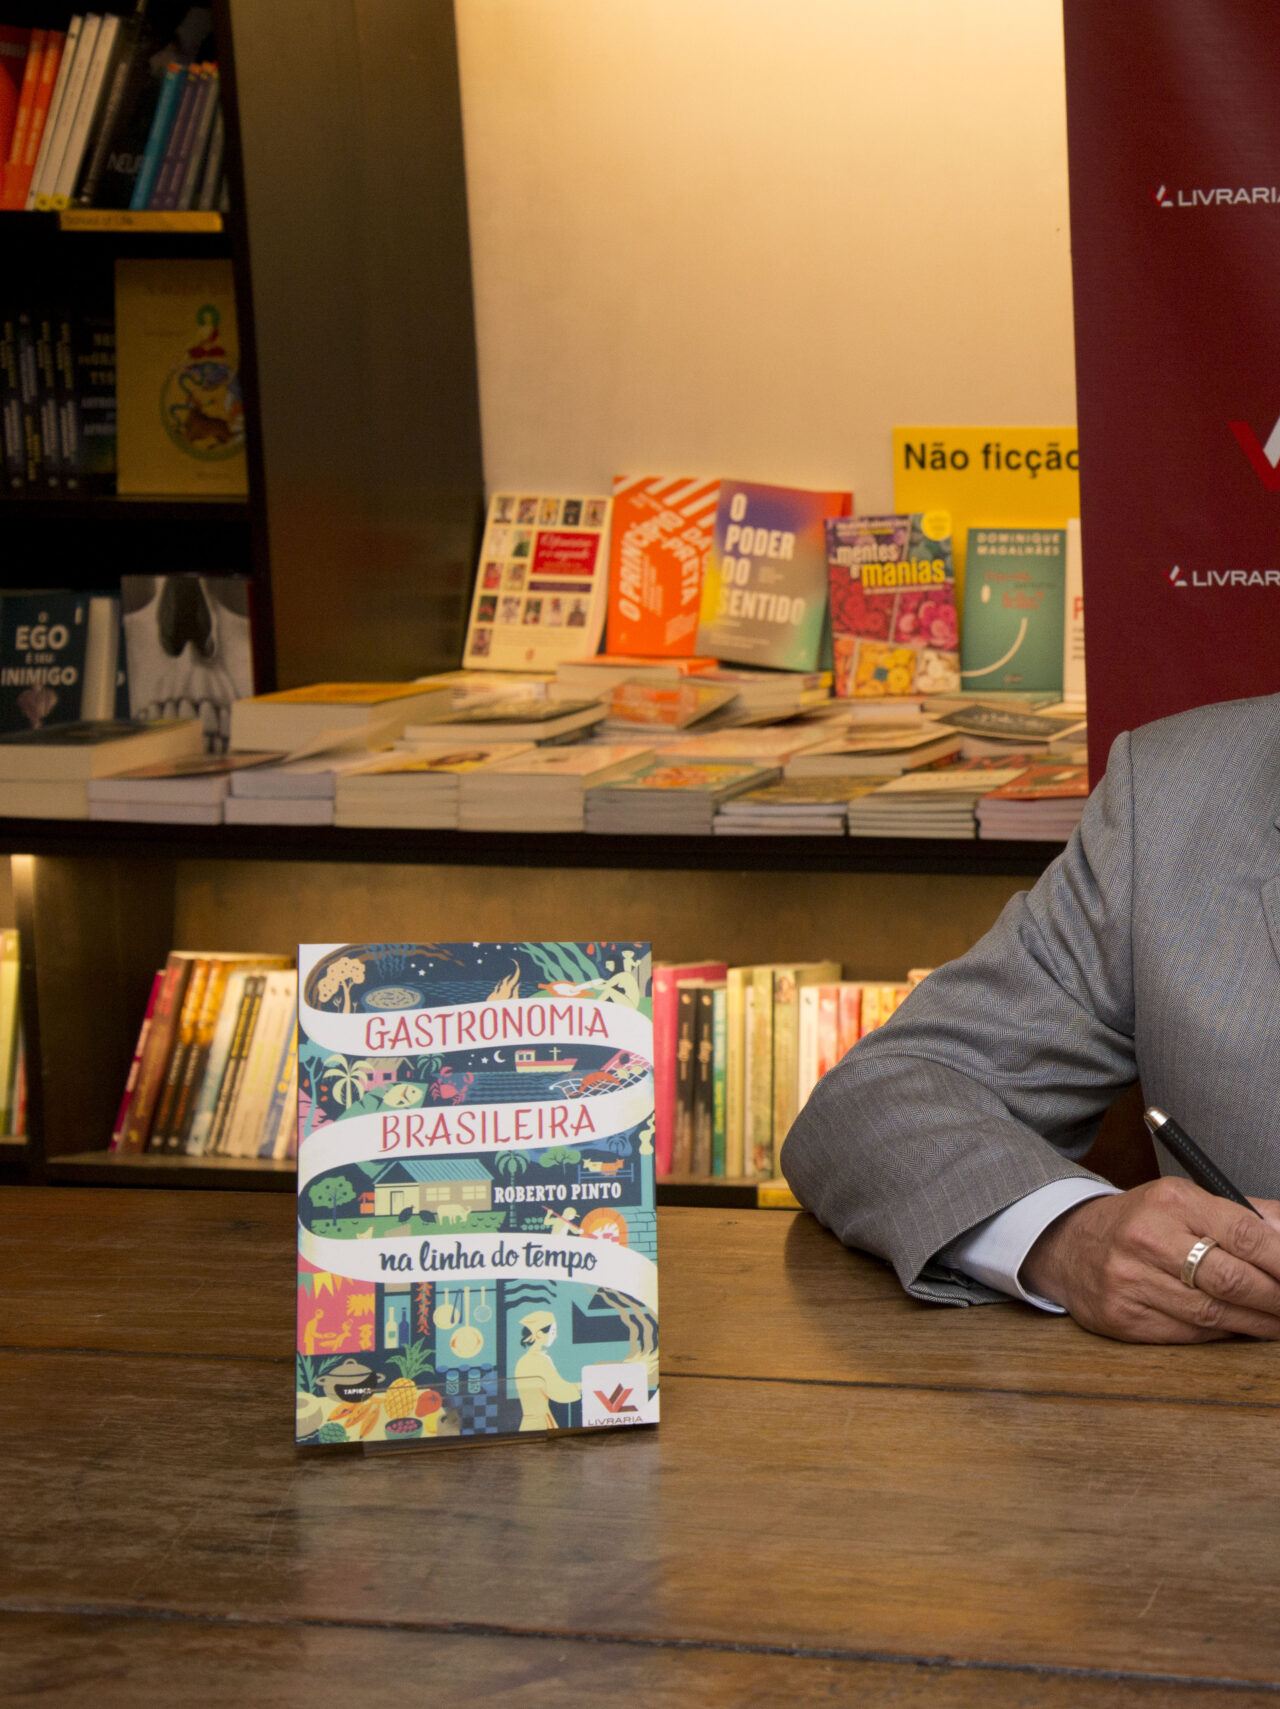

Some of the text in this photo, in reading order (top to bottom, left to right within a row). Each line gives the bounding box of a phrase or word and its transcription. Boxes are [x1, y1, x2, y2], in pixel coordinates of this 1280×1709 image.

[904, 441, 1079, 479] Não ficção
[724, 523, 796, 561] PODER
[836, 543, 899, 563] mentes
[720, 555, 752, 587] DO
[861, 556, 946, 588] manias
[716, 585, 807, 626] SENTIDO
[15, 624, 69, 651] EGO
[1, 666, 78, 687] INIMIGO
[365, 1004, 610, 1051] GASTRONOMIA
[377, 1104, 596, 1152] BRASILEIRA
[493, 1182, 622, 1204] ROBERTO PINTO
[379, 1239, 598, 1278] na linha do tempo
[587, 1415, 644, 1427] LIVRARIA
